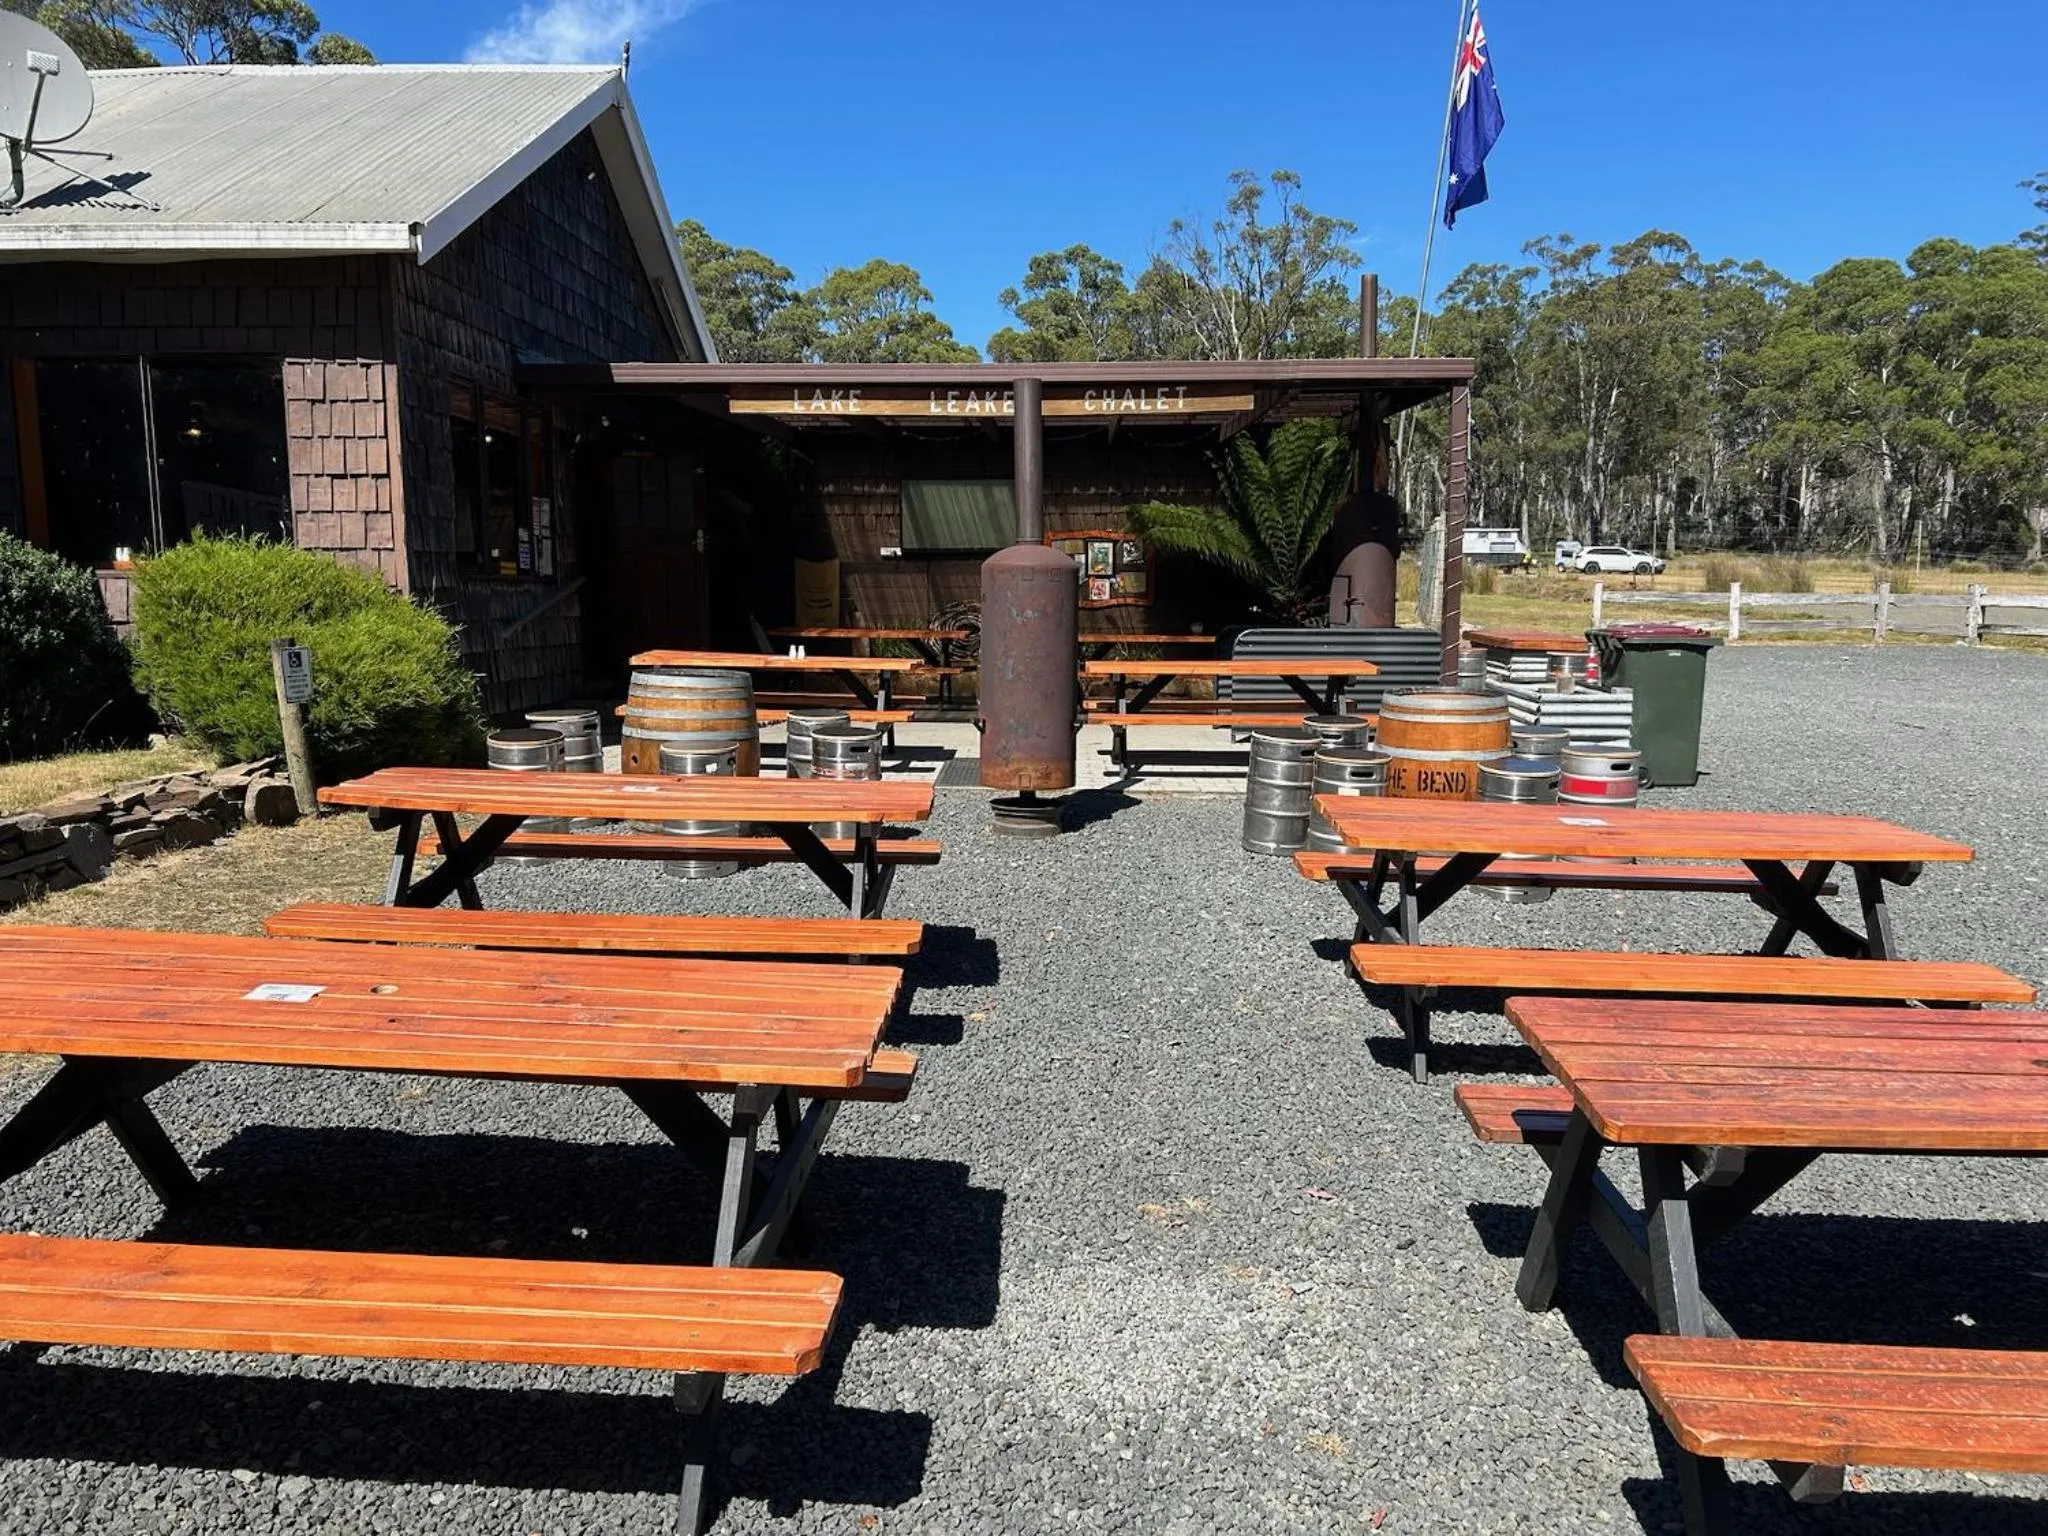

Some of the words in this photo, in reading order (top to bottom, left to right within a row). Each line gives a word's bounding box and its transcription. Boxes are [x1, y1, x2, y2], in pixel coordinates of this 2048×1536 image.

[792, 388, 862, 412] LAKE
[929, 390, 1015, 413] LEAKE
[1084, 386, 1187, 411] CHALET
[1388, 768, 1408, 790] HE
[1418, 770, 1467, 794] BEND
